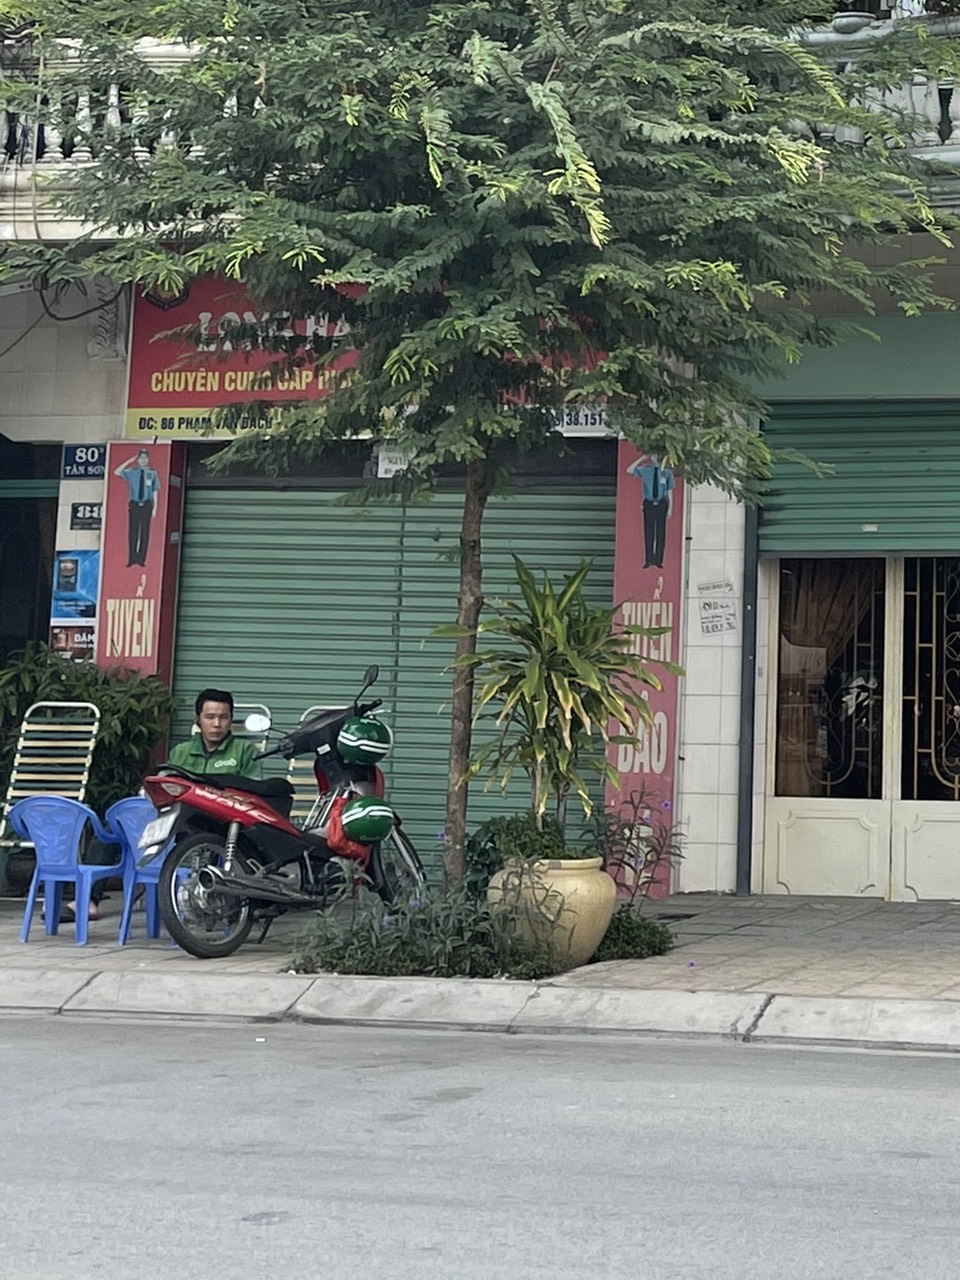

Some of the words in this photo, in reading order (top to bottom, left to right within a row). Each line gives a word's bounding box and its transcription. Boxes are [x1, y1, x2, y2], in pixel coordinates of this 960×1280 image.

[151, 368, 219, 393] CHUYÊN
[161, 416, 175, 430] 86
[105, 574, 155, 658] TUYỂN
